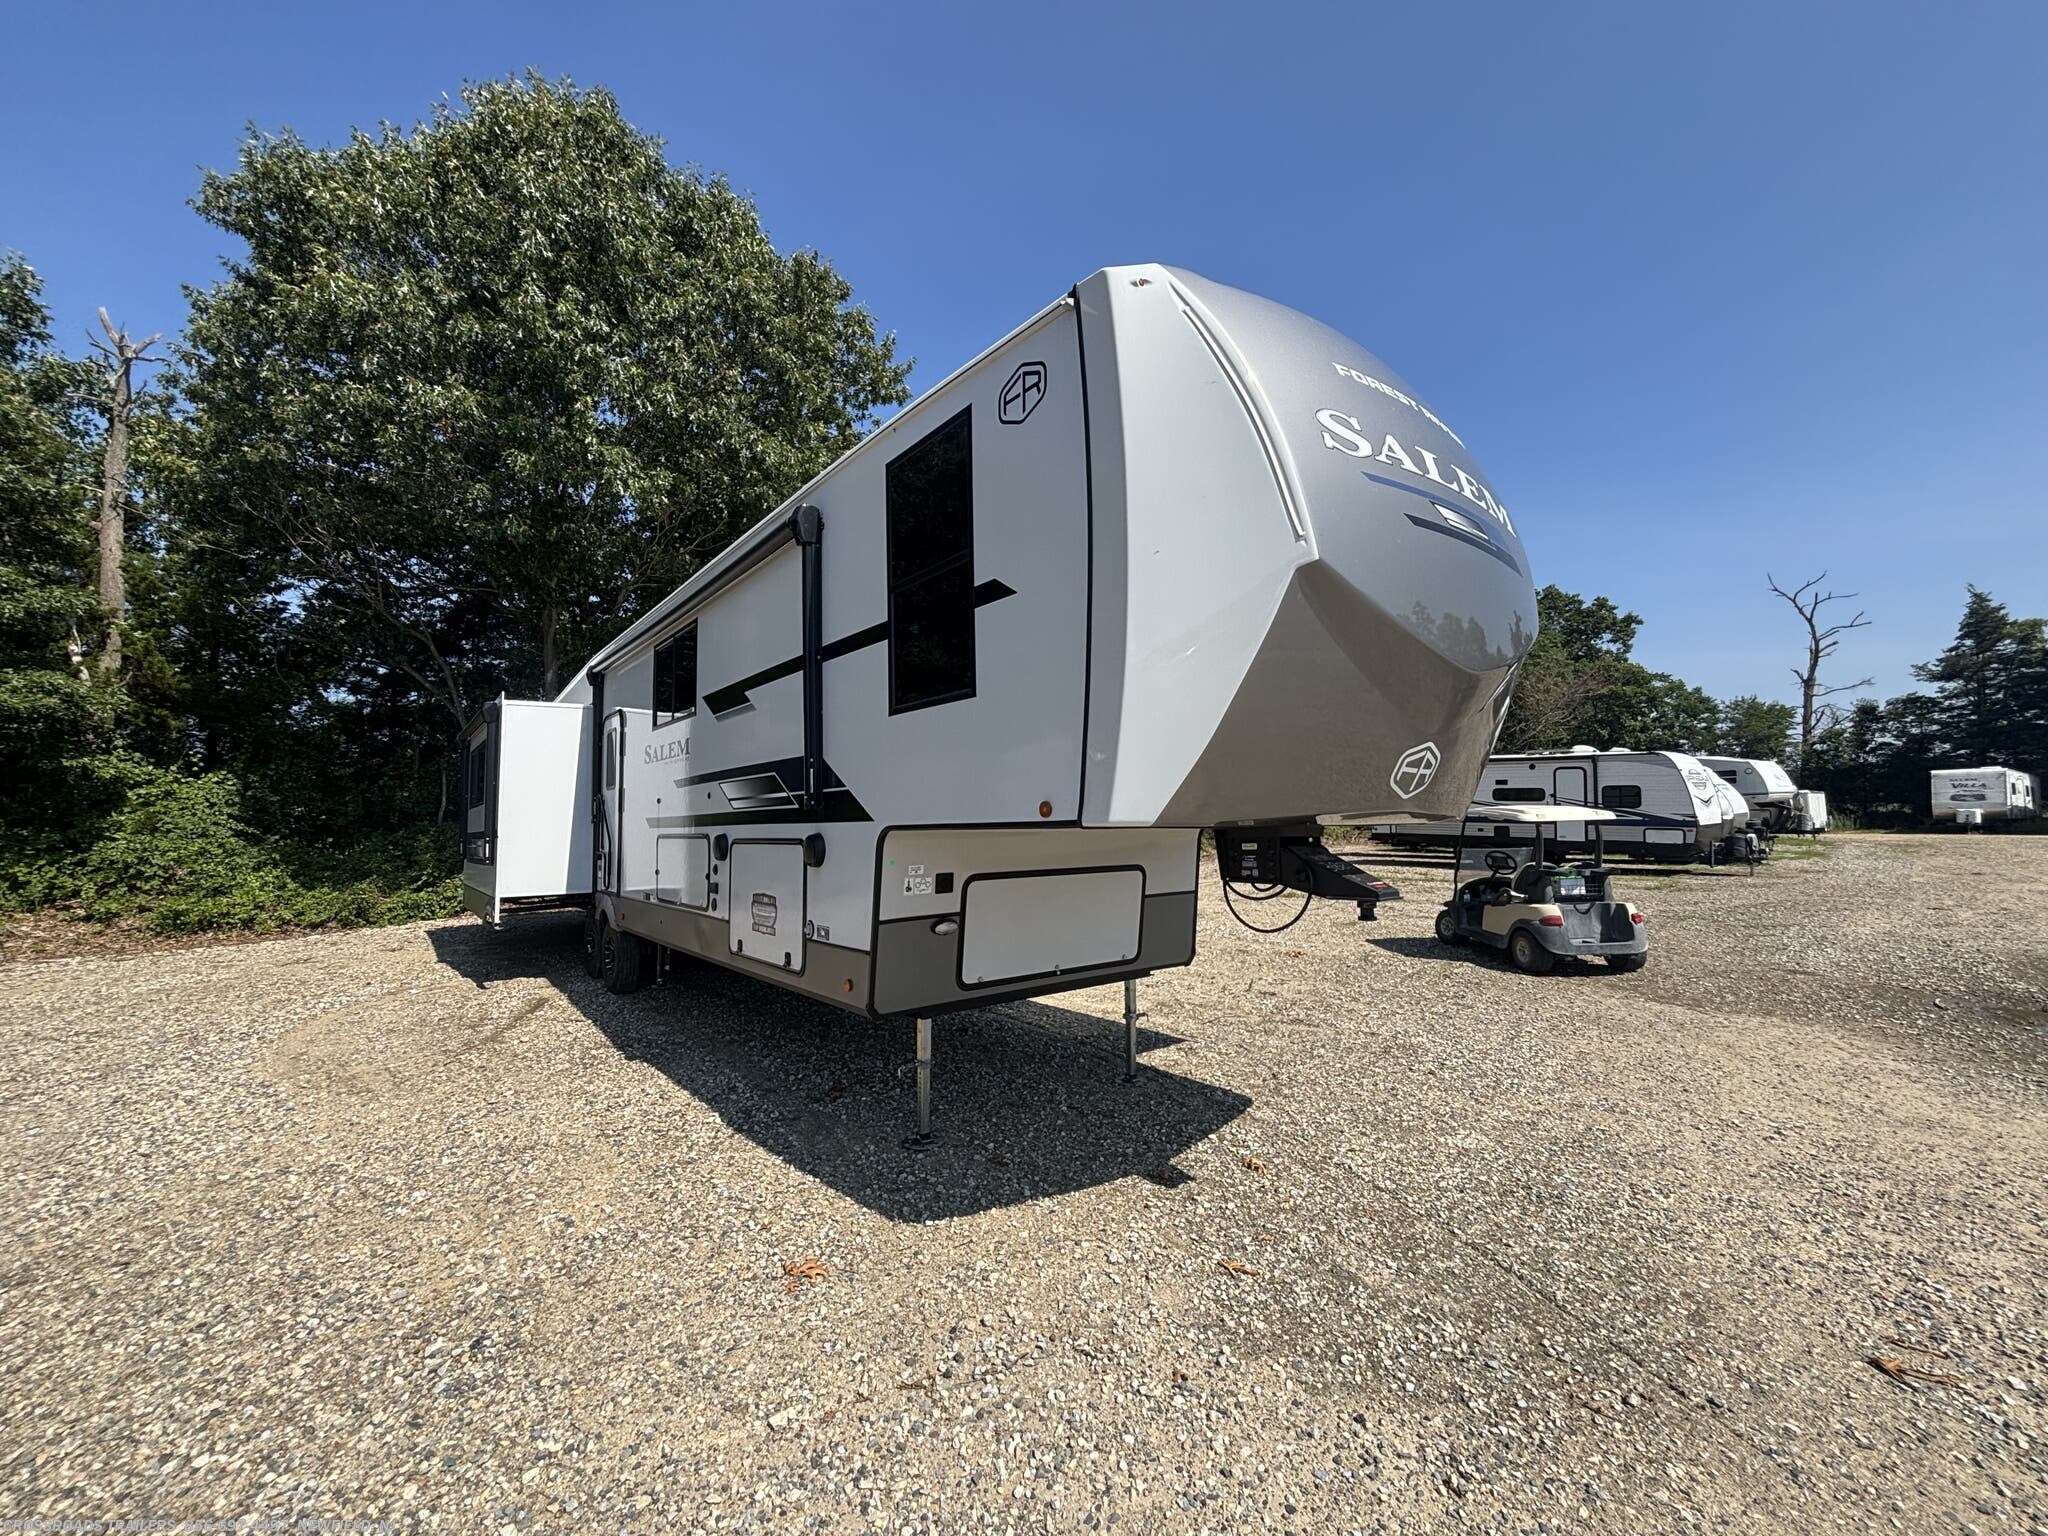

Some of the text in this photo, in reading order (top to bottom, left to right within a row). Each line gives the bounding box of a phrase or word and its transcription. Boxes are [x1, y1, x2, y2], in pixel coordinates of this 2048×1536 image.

[1331, 361, 1419, 411] FOREST
[1314, 407, 1517, 538] SALEM
[644, 737, 691, 765] SALEM
